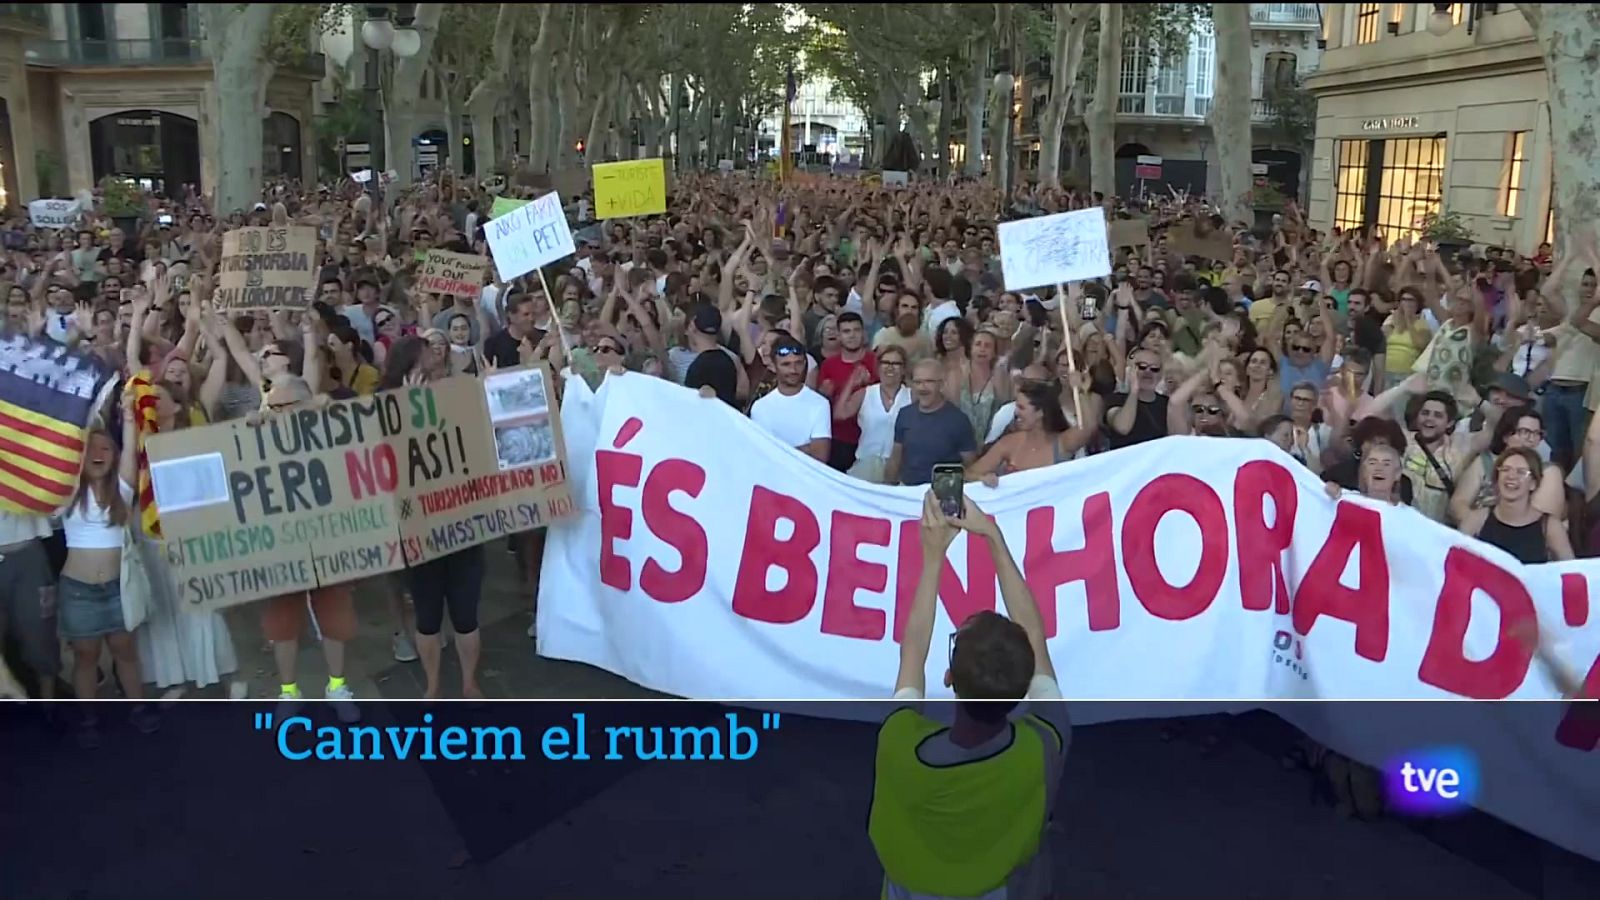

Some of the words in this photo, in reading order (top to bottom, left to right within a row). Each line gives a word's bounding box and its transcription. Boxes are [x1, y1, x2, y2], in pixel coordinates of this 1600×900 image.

[46, 202, 68, 212] SOS
[230, 457, 333, 524] PERO
[344, 442, 400, 500] NO
[280, 503, 389, 544] SOSTENIBLE
[595, 417, 708, 603] ÉS
[315, 545, 383, 579] TURISM
